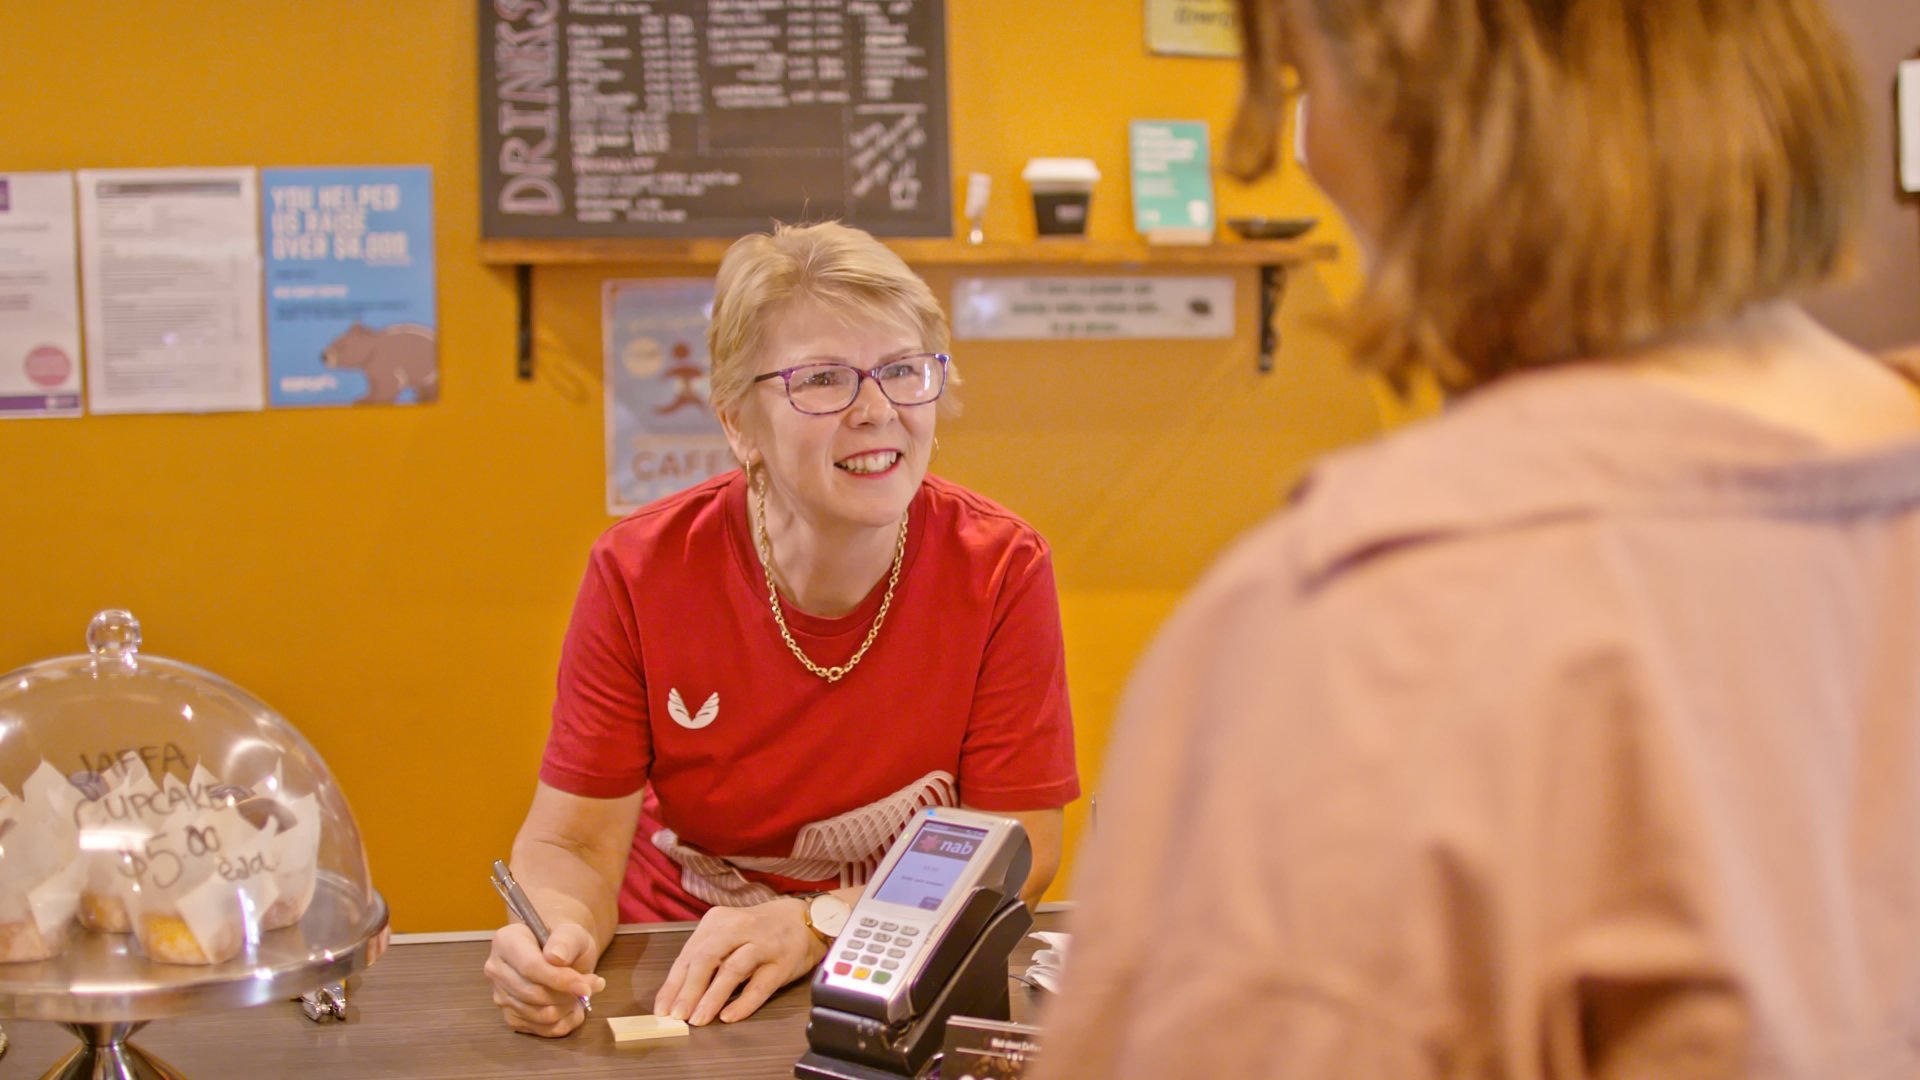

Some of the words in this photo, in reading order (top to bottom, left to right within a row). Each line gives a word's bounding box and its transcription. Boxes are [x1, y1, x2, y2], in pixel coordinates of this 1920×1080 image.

[271, 185, 313, 209] YOU
[318, 184, 402, 211] HELPED
[273, 232, 328, 260] OVER
[938, 837, 974, 856] nab
